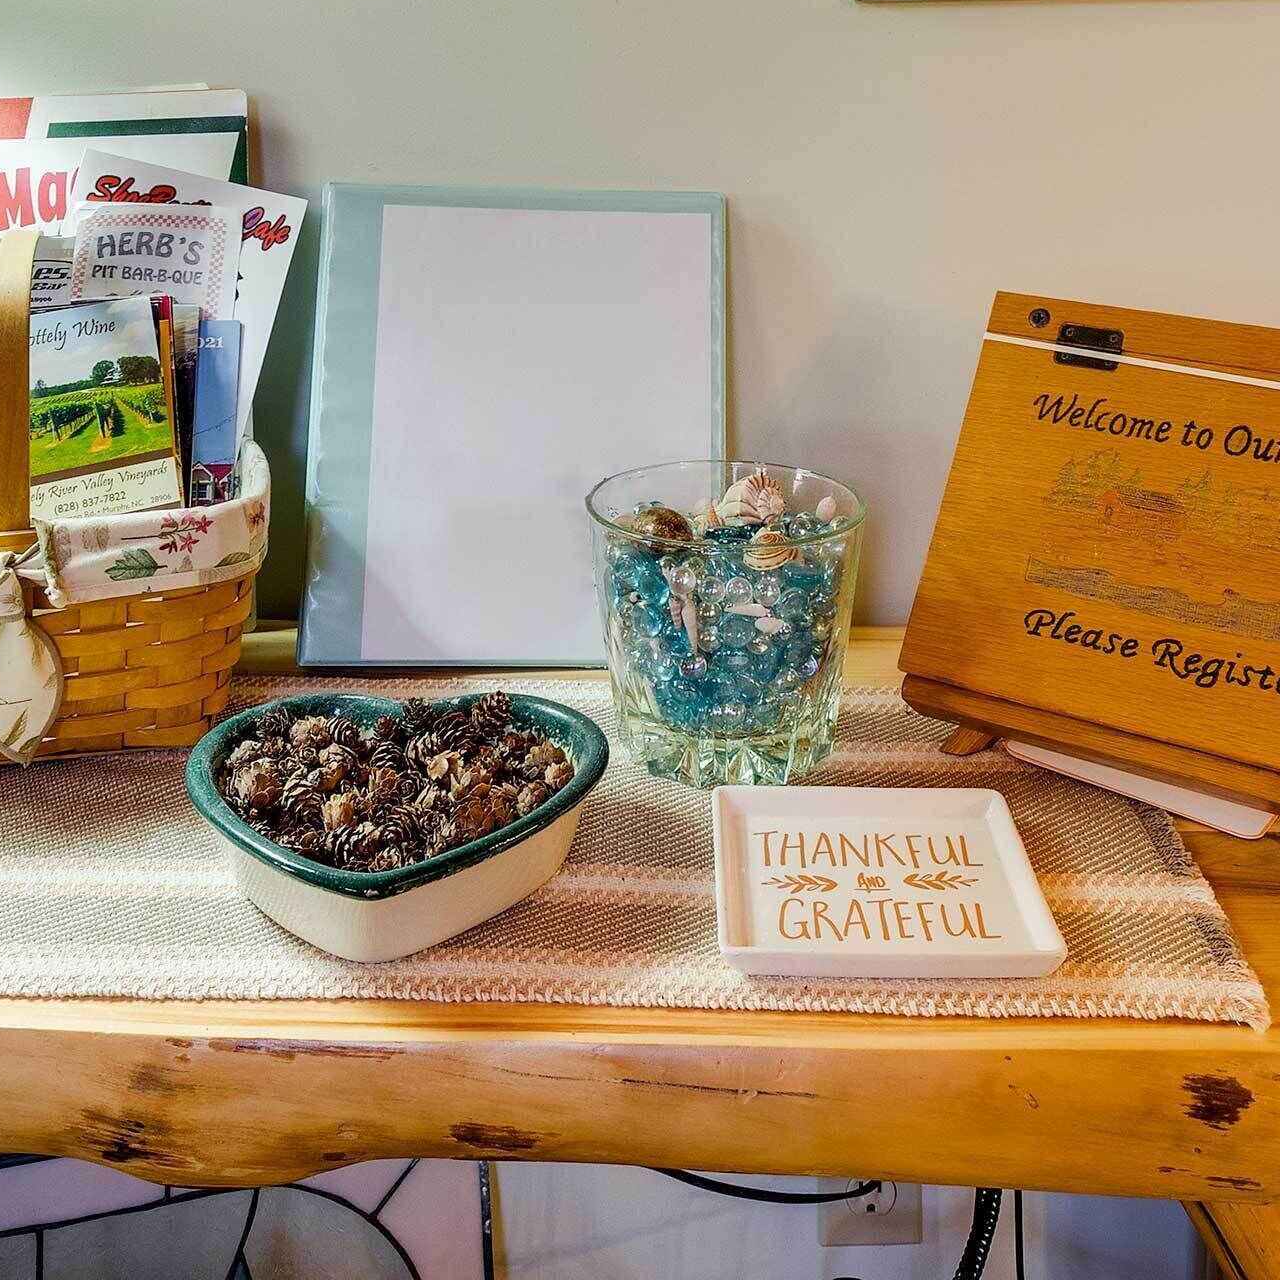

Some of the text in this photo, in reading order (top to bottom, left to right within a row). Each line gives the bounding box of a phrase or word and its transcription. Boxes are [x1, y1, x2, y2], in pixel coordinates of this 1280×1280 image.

[242, 206, 292, 252] Cafe
[96, 231, 205, 266] HERB'S
[91, 264, 203, 285] PIT BAR-B-QUE
[29, 318, 116, 351] ottely Wine
[197, 336, 224, 349] 021
[1032, 391, 1172, 443] Welcome
[1180, 418, 1215, 450] to
[48, 484, 78, 499] River
[81, 473, 114, 492] Valley
[118, 460, 168, 485] Vineyards
[54, 491, 127, 516] (828) 837-7822
[1024, 609, 1140, 659] Please
[753, 830, 984, 869] THANKFUL
[857, 871, 888, 890] AND
[778, 898, 1002, 942] GRATEFUL
